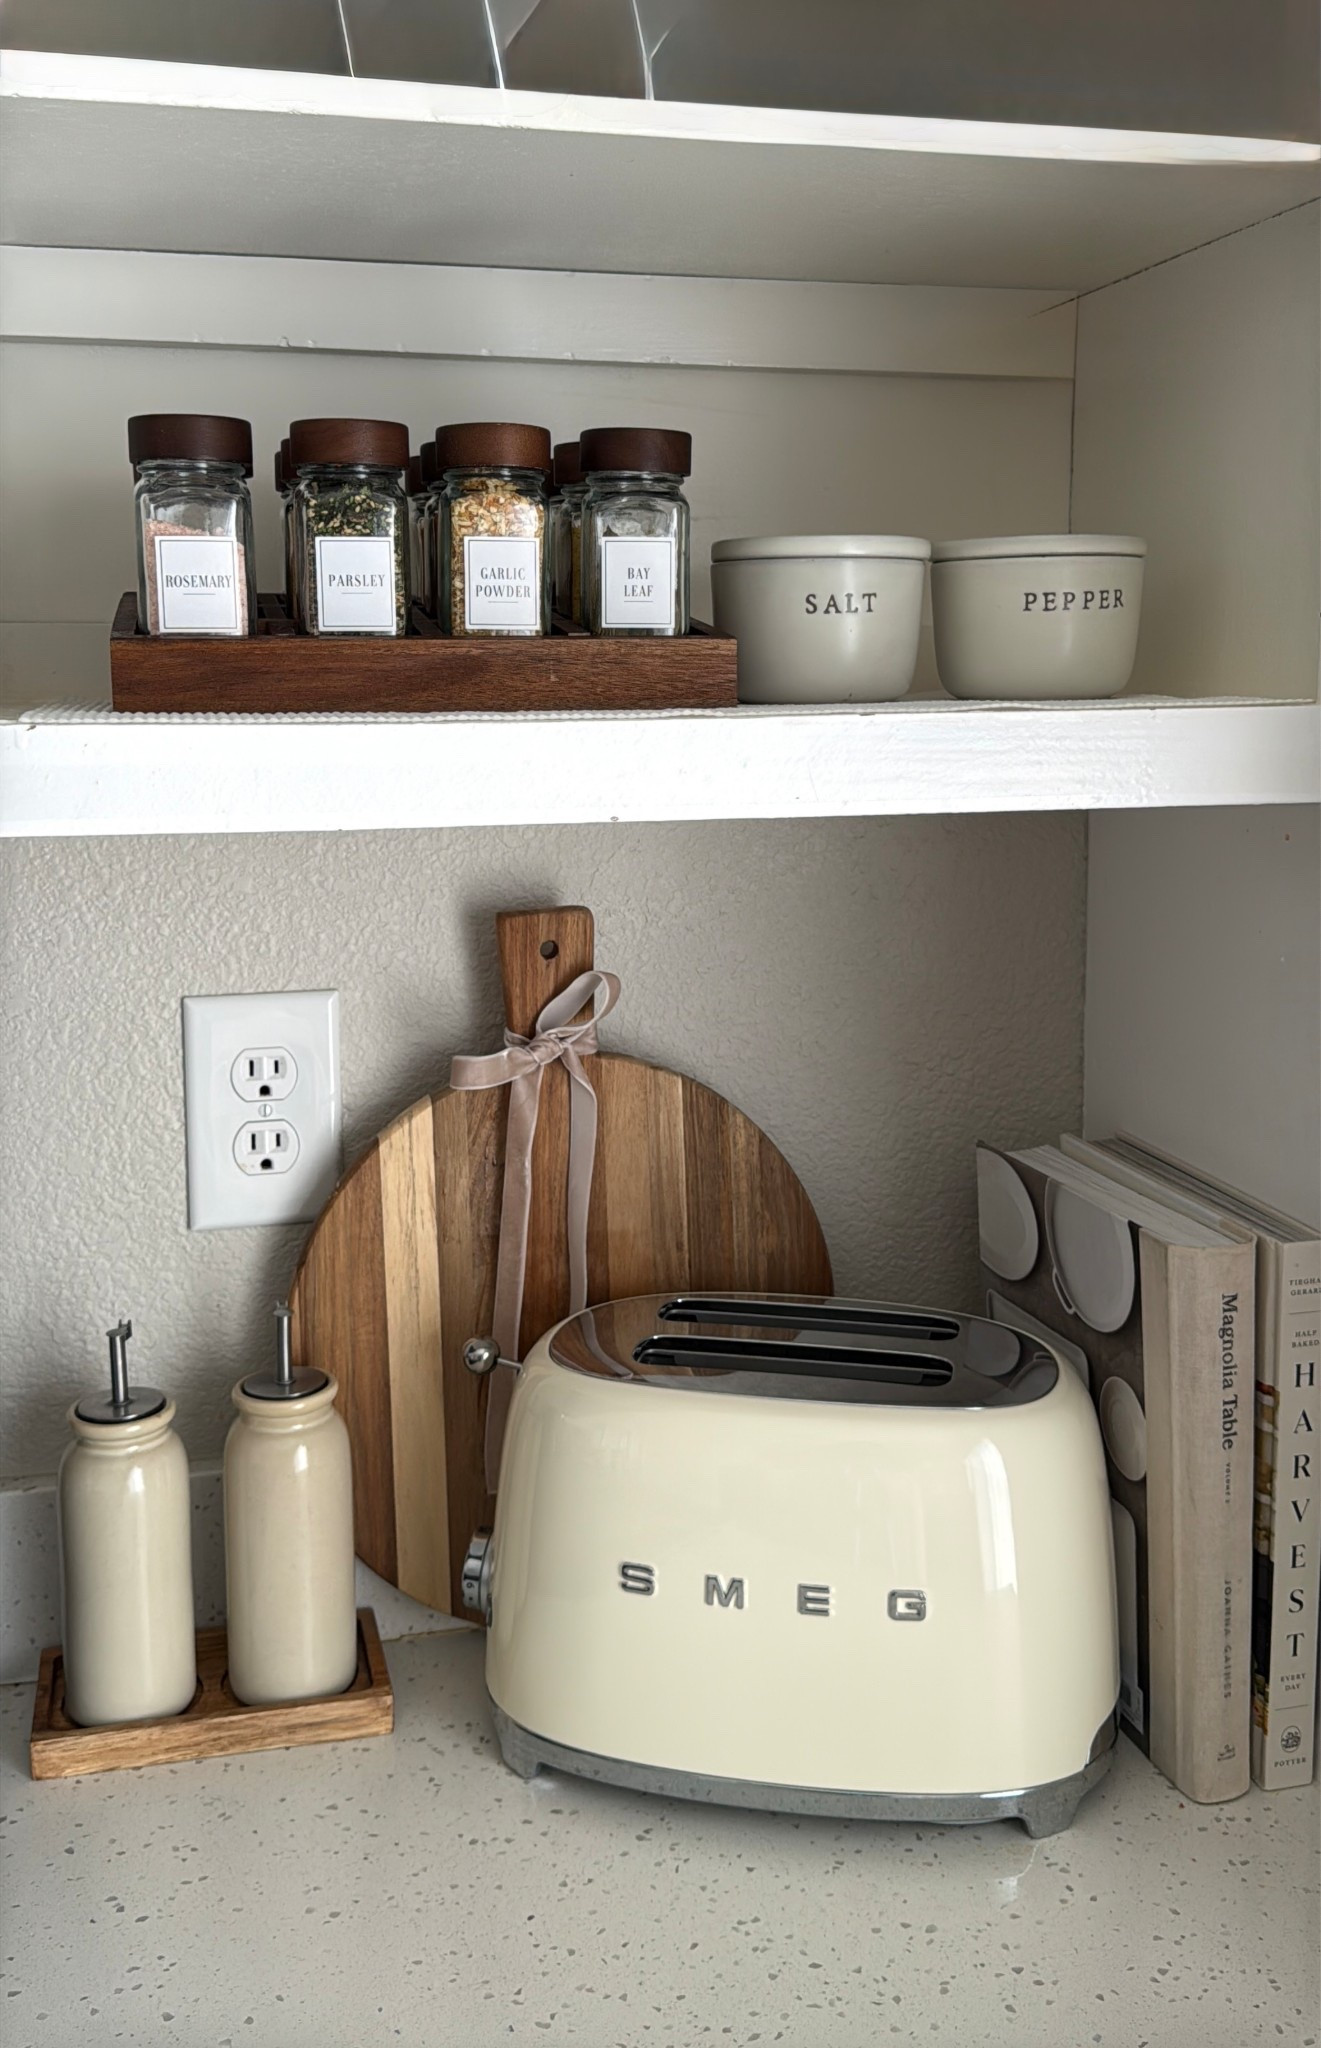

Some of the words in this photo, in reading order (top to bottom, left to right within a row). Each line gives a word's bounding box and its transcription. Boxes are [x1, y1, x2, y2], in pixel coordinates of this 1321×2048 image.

[480, 567, 526, 580] GARLIC
[627, 567, 651, 580] BAY
[165, 574, 232, 588] ROSEMARY
[328, 574, 386, 588] PARSLEY
[475, 584, 531, 598] POWDER
[624, 584, 654, 597] LEAF
[805, 592, 877, 614] SALT
[1022, 589, 1124, 612] PEPPER
[1218, 1293, 1238, 1390] Magnolia
[1291, 1339, 1320, 1348] BAKED
[1222, 1394, 1238, 1450] Table
[1286, 1362, 1315, 1658] HARVEST
[618, 1561, 927, 1622] SMEG
[1224, 1580, 1232, 1636] JOANNA
[1224, 1645, 1232, 1699] GAINES
[1280, 1673, 1306, 1682] EVERY
[1285, 1683, 1300, 1691] DAY
[1274, 1757, 1306, 1768] POTTER
